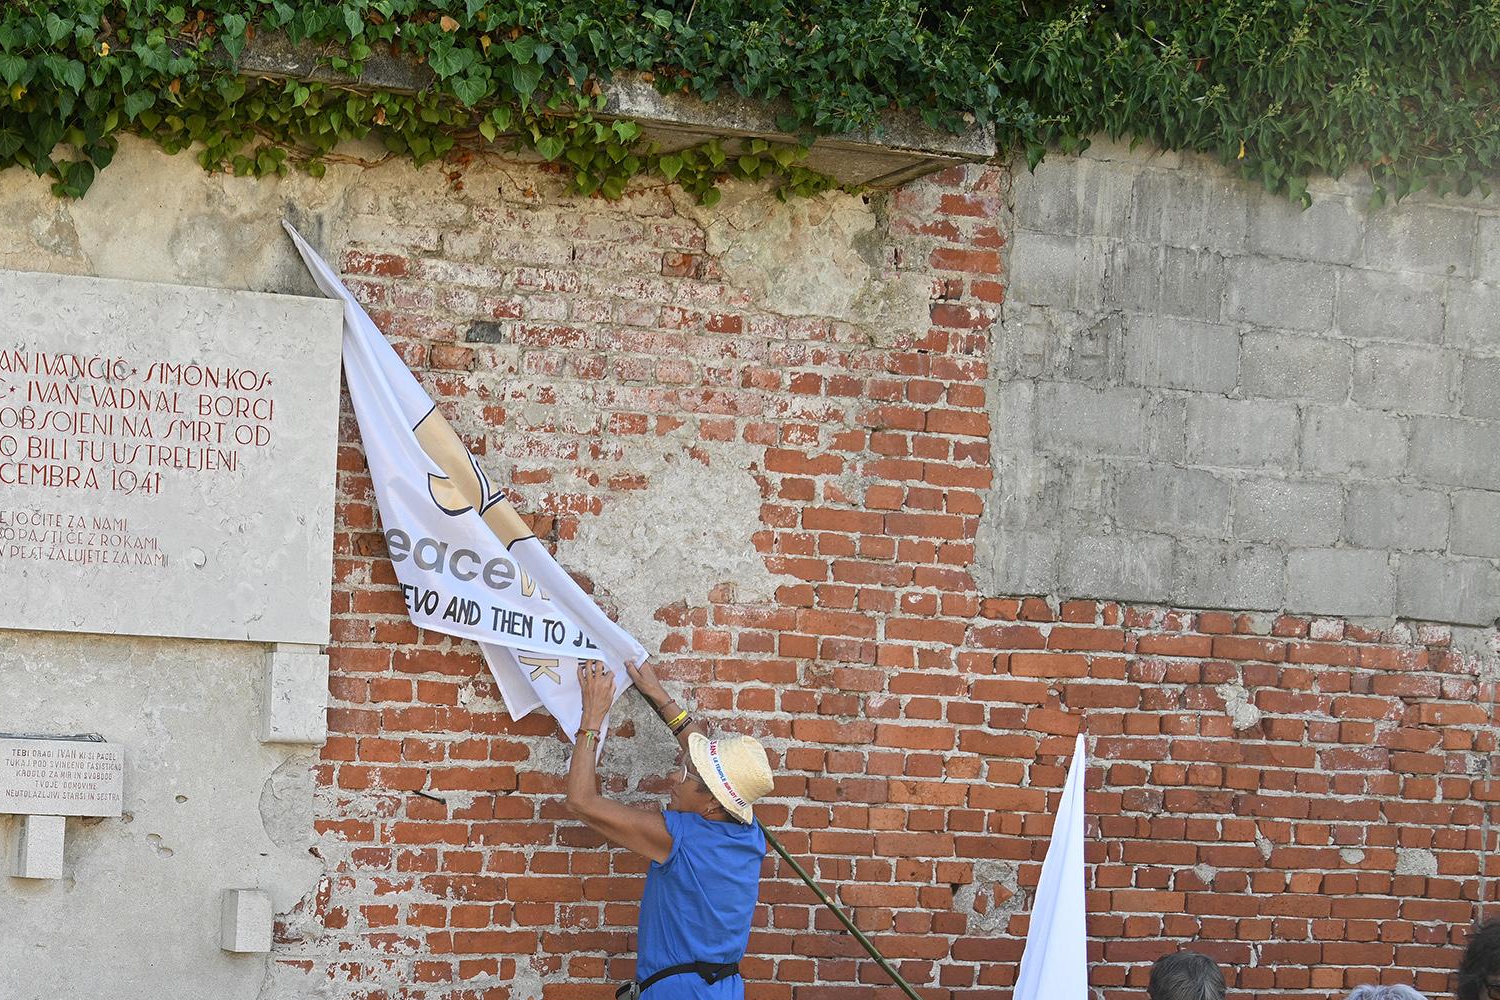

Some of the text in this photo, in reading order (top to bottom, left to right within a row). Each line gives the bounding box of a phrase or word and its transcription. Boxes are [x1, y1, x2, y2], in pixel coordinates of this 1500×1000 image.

[35, 351, 129, 381] IVANČIČ
[143, 363, 220, 388] SIMON
[227, 368, 269, 391] KOS
[28, 381, 79, 406] IVAN
[91, 385, 184, 413] VADNAL
[199, 394, 273, 420] BORCI
[0, 405, 113, 436] OBSOJENI
[122, 415, 153, 438] NA
[164, 419, 226, 443] SMRT
[235, 424, 271, 446] OD
[28, 436, 67, 460] BILI
[77, 440, 104, 462] TU
[113, 442, 237, 472] USTRELJENI
[112, 469, 161, 495] 1941
[68, 515, 86, 529] ZA
[88, 533, 96, 546] Z
[113, 550, 130, 565] ZA
[386, 527, 516, 590] eace
[443, 596, 481, 626] AND
[491, 606, 533, 639] THEN
[542, 618, 566, 645] TO
